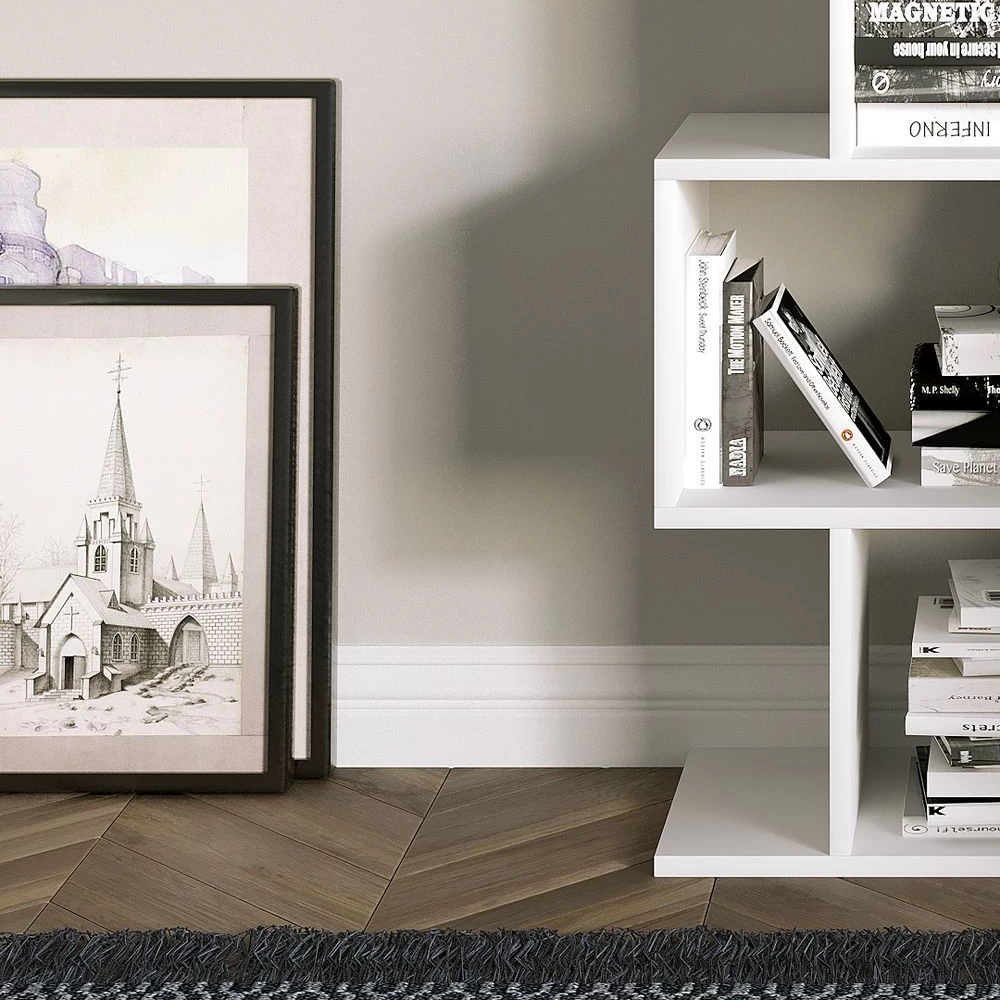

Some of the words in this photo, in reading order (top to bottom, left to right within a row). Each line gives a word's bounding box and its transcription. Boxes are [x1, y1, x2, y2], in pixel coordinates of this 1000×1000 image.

[868, 1, 995, 23] MAGNETIC
[893, 41, 924, 60] house
[926, 41, 948, 57] your
[949, 42, 960, 60] in
[961, 42, 996, 59] secure
[909, 121, 990, 138] INFERNO
[698, 258, 708, 275] John
[698, 276, 709, 309] Steinbeck
[728, 294, 745, 324] MAKER
[728, 325, 745, 357] MOTION
[764, 317, 781, 338] Samuel
[776, 335, 794, 356] Beckett
[728, 358, 745, 375] THE
[921, 386, 931, 394] M.
[932, 386, 939, 394] P.
[939, 386, 961, 396] Shelly
[987, 385, 1000, 395] The
[932, 461, 960, 474] Save
[964, 461, 997, 474] Planet
[947, 694, 993, 703] Barney
